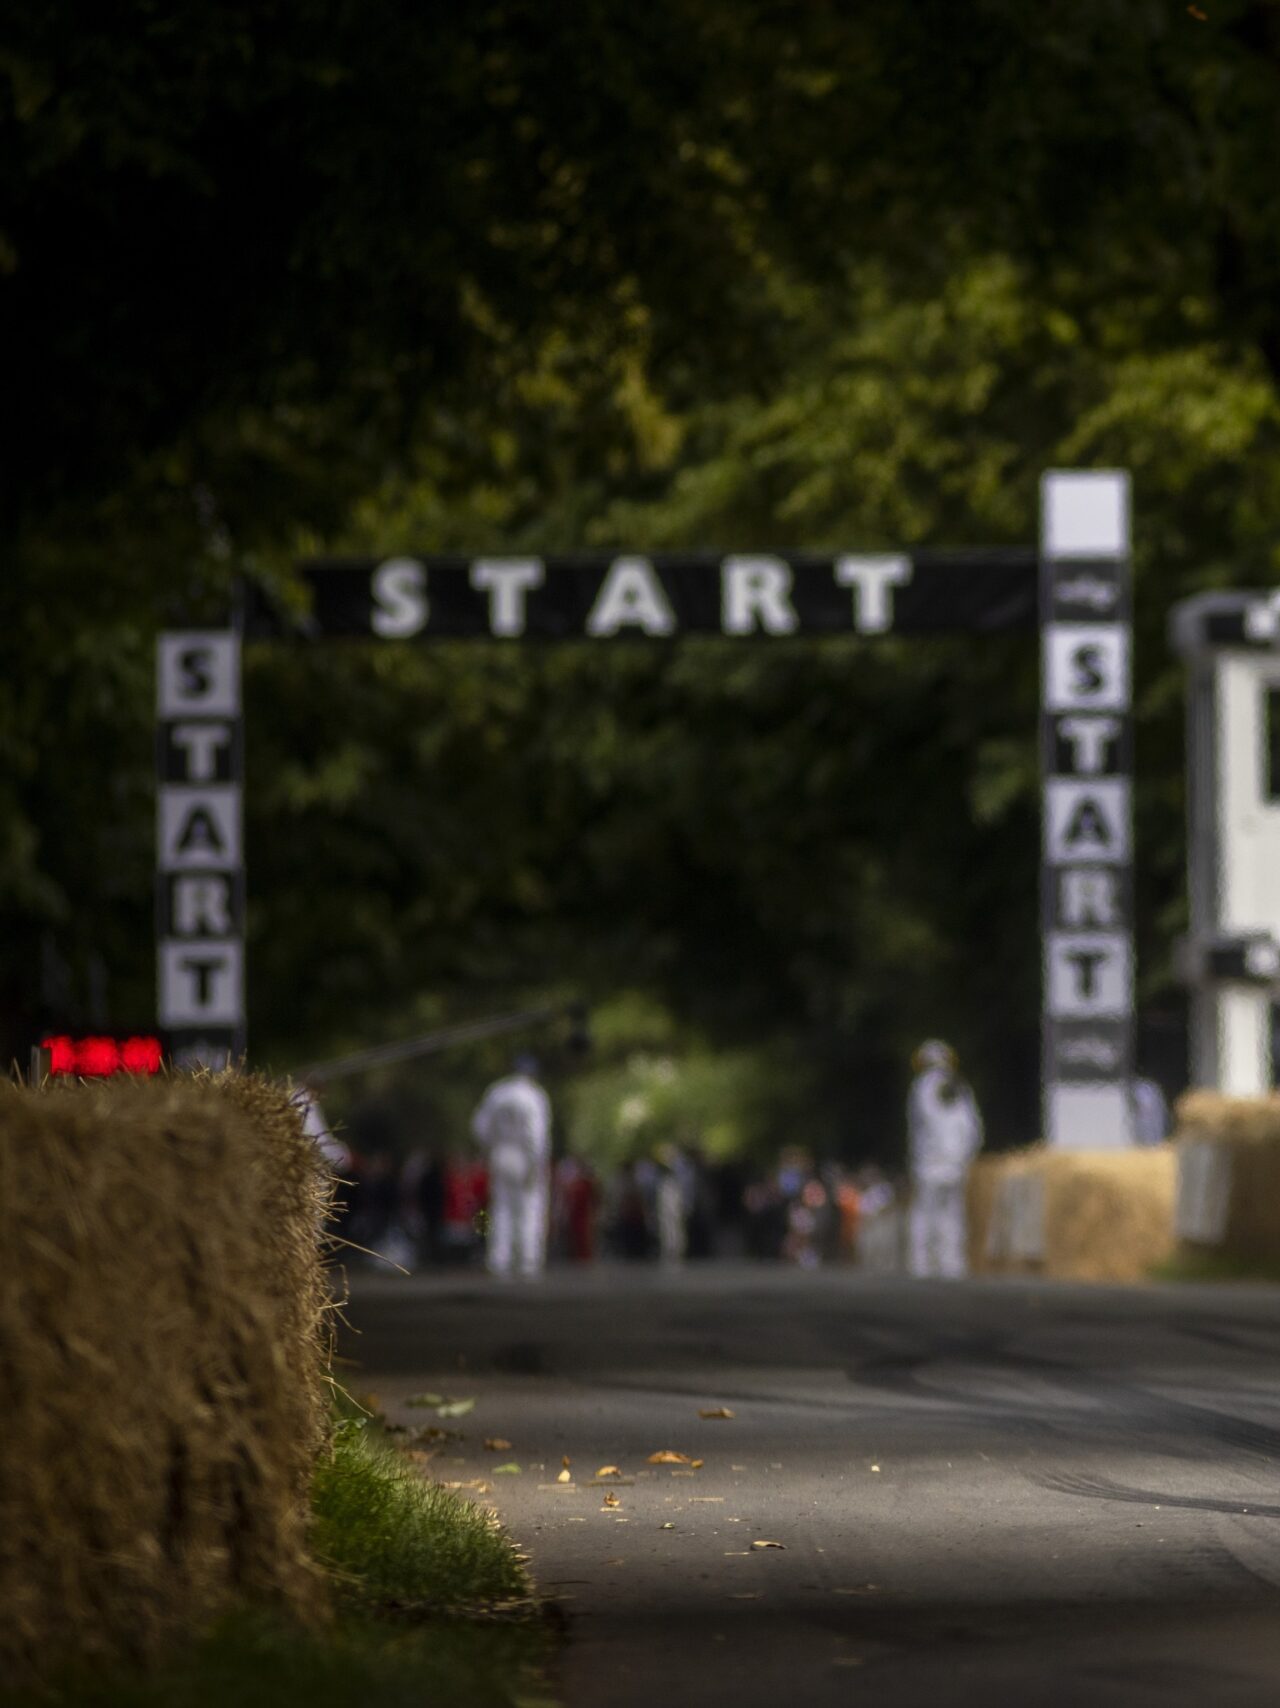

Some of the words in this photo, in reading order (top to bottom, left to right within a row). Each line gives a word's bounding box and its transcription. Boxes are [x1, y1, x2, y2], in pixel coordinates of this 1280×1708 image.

[371, 555, 912, 640] START
[168, 645, 232, 1010] START
[1056, 644, 1118, 1001] START
